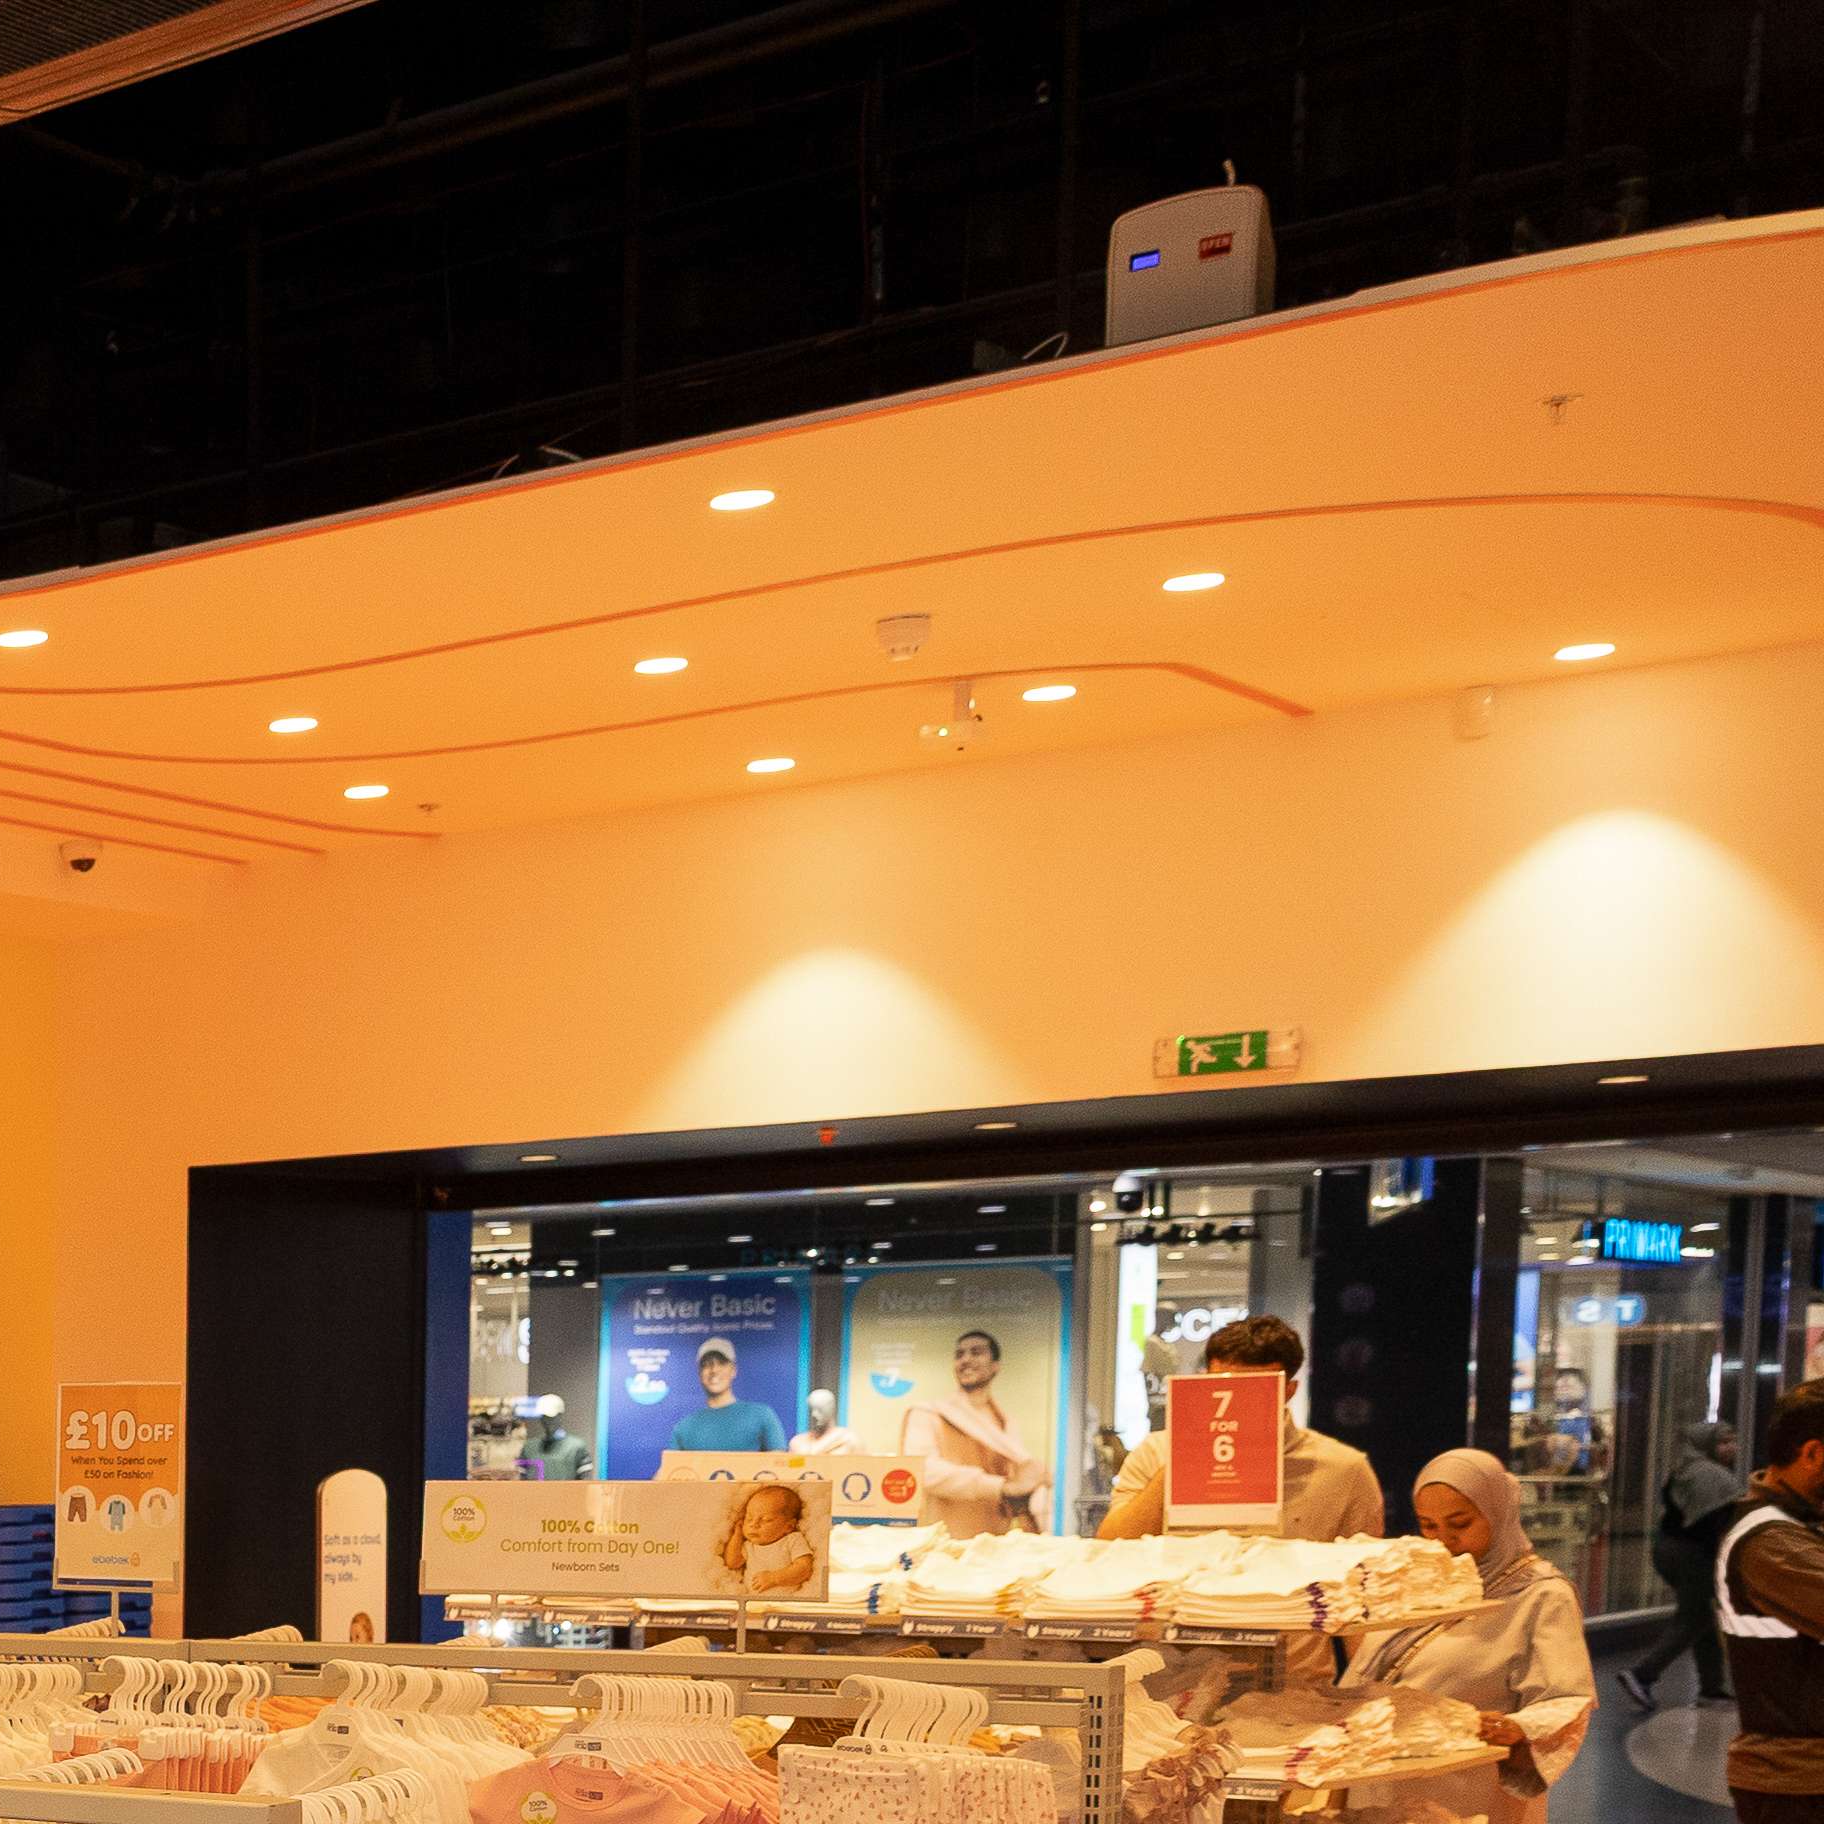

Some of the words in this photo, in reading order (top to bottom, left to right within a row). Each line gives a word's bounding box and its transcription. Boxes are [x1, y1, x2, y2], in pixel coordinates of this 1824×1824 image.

[632, 1296, 702, 1320] Never
[711, 1292, 777, 1317] Basic
[1212, 1390, 1233, 1418] 7
[65, 1410, 136, 1450] £10
[137, 1423, 174, 1442] OFF
[1209, 1420, 1239, 1432] FOR
[1213, 1434, 1235, 1462] 6
[71, 1456, 95, 1465] When
[98, 1456, 114, 1465] You
[117, 1456, 144, 1467] Spend
[147, 1457, 168, 1465] over
[84, 1470, 101, 1479] £50
[117, 1470, 154, 1479] Fashion!
[453, 1507, 475, 1516] 100%
[541, 1519, 580, 1534] 100%
[500, 1538, 563, 1554] Comfort
[567, 1539, 603, 1553] from
[608, 1540, 637, 1558] Day
[643, 1541, 679, 1555] One!
[551, 1561, 596, 1572] Newborn
[599, 1563, 620, 1573] Sets
